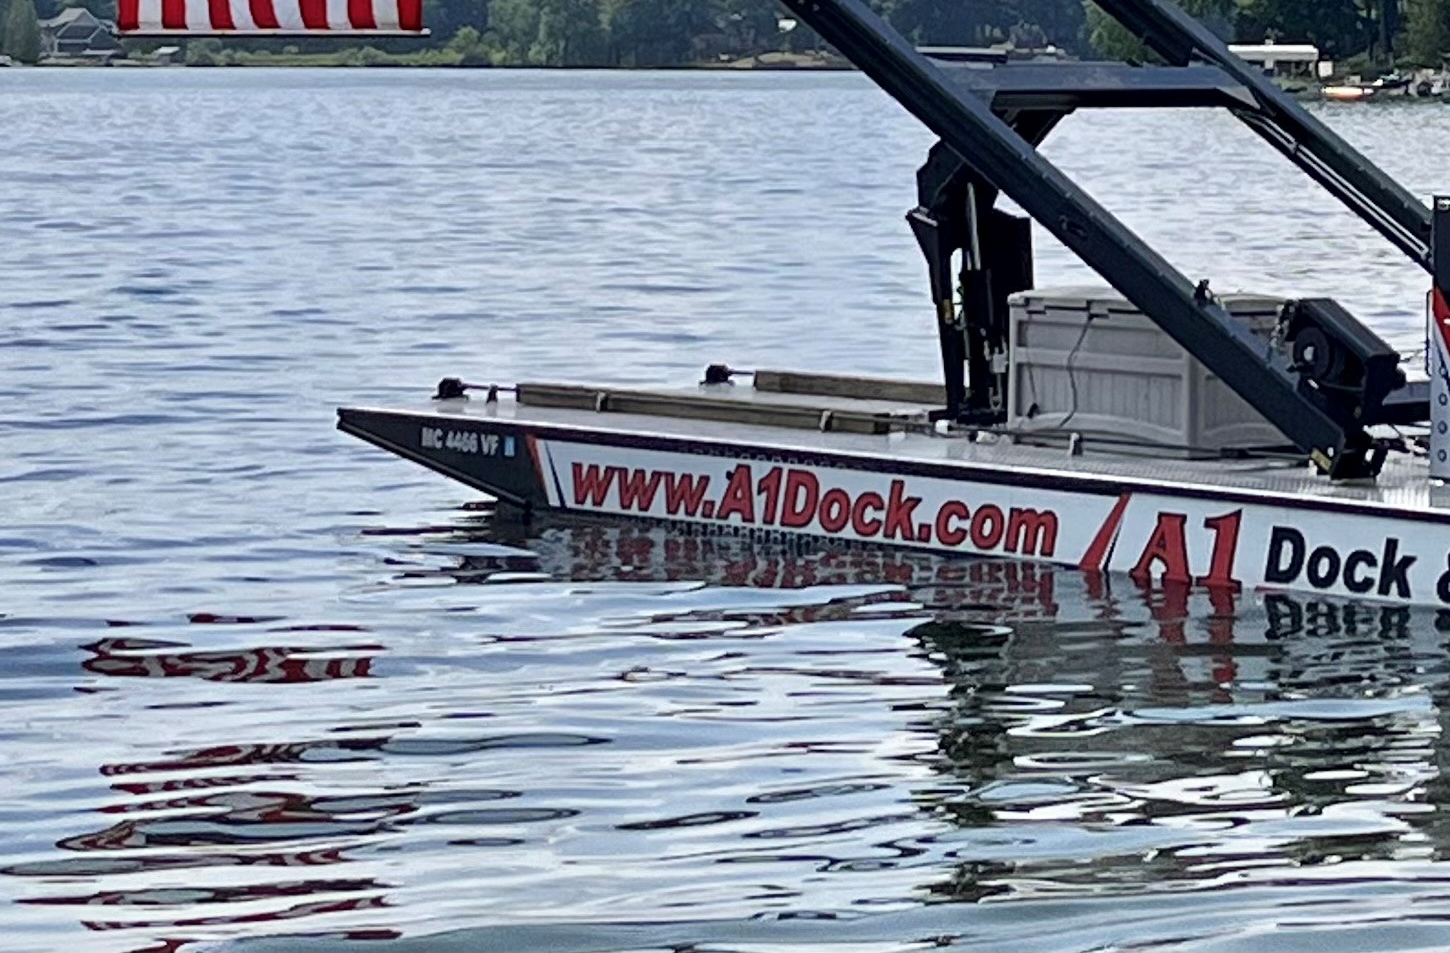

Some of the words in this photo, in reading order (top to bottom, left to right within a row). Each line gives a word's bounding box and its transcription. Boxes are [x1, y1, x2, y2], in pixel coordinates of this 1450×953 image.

[571, 462, 1059, 557] www.A1Dock.com
[1129, 508, 1243, 588] A1
[1264, 525, 1417, 598] Dock
